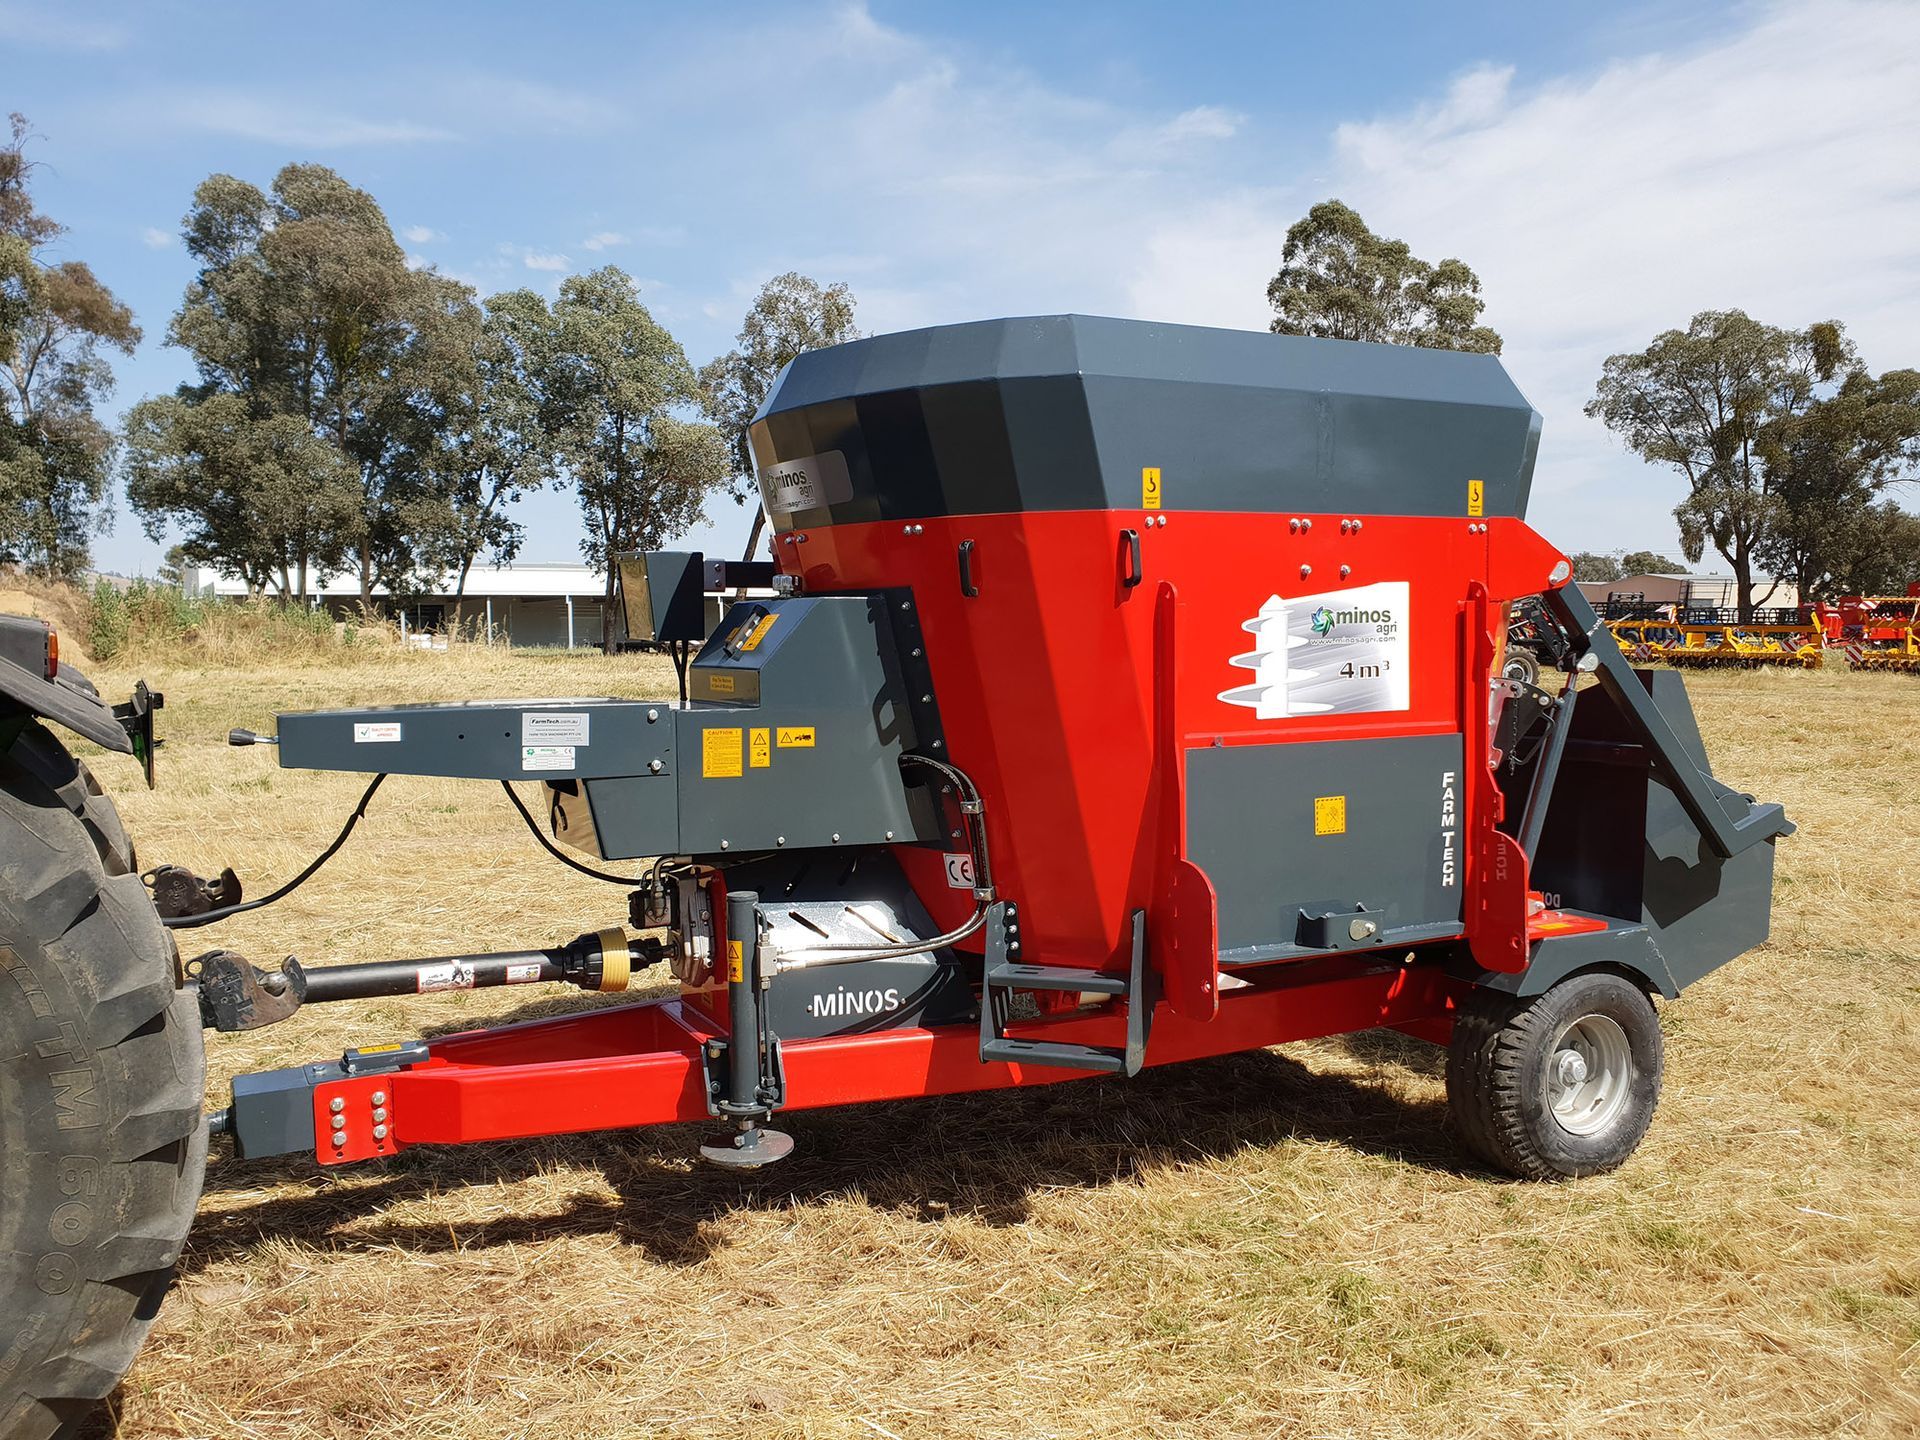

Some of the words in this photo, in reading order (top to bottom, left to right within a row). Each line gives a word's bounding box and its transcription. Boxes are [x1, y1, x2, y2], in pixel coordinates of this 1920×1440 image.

[799, 481, 814, 497] agri
[1336, 606, 1392, 624] minos
[1376, 621, 1397, 635] agri
[1309, 636, 1397, 645] www.minosagri.com
[1340, 662, 1355, 679] 4
[1441, 772, 1455, 827] FARM
[1442, 831, 1455, 886] TECH
